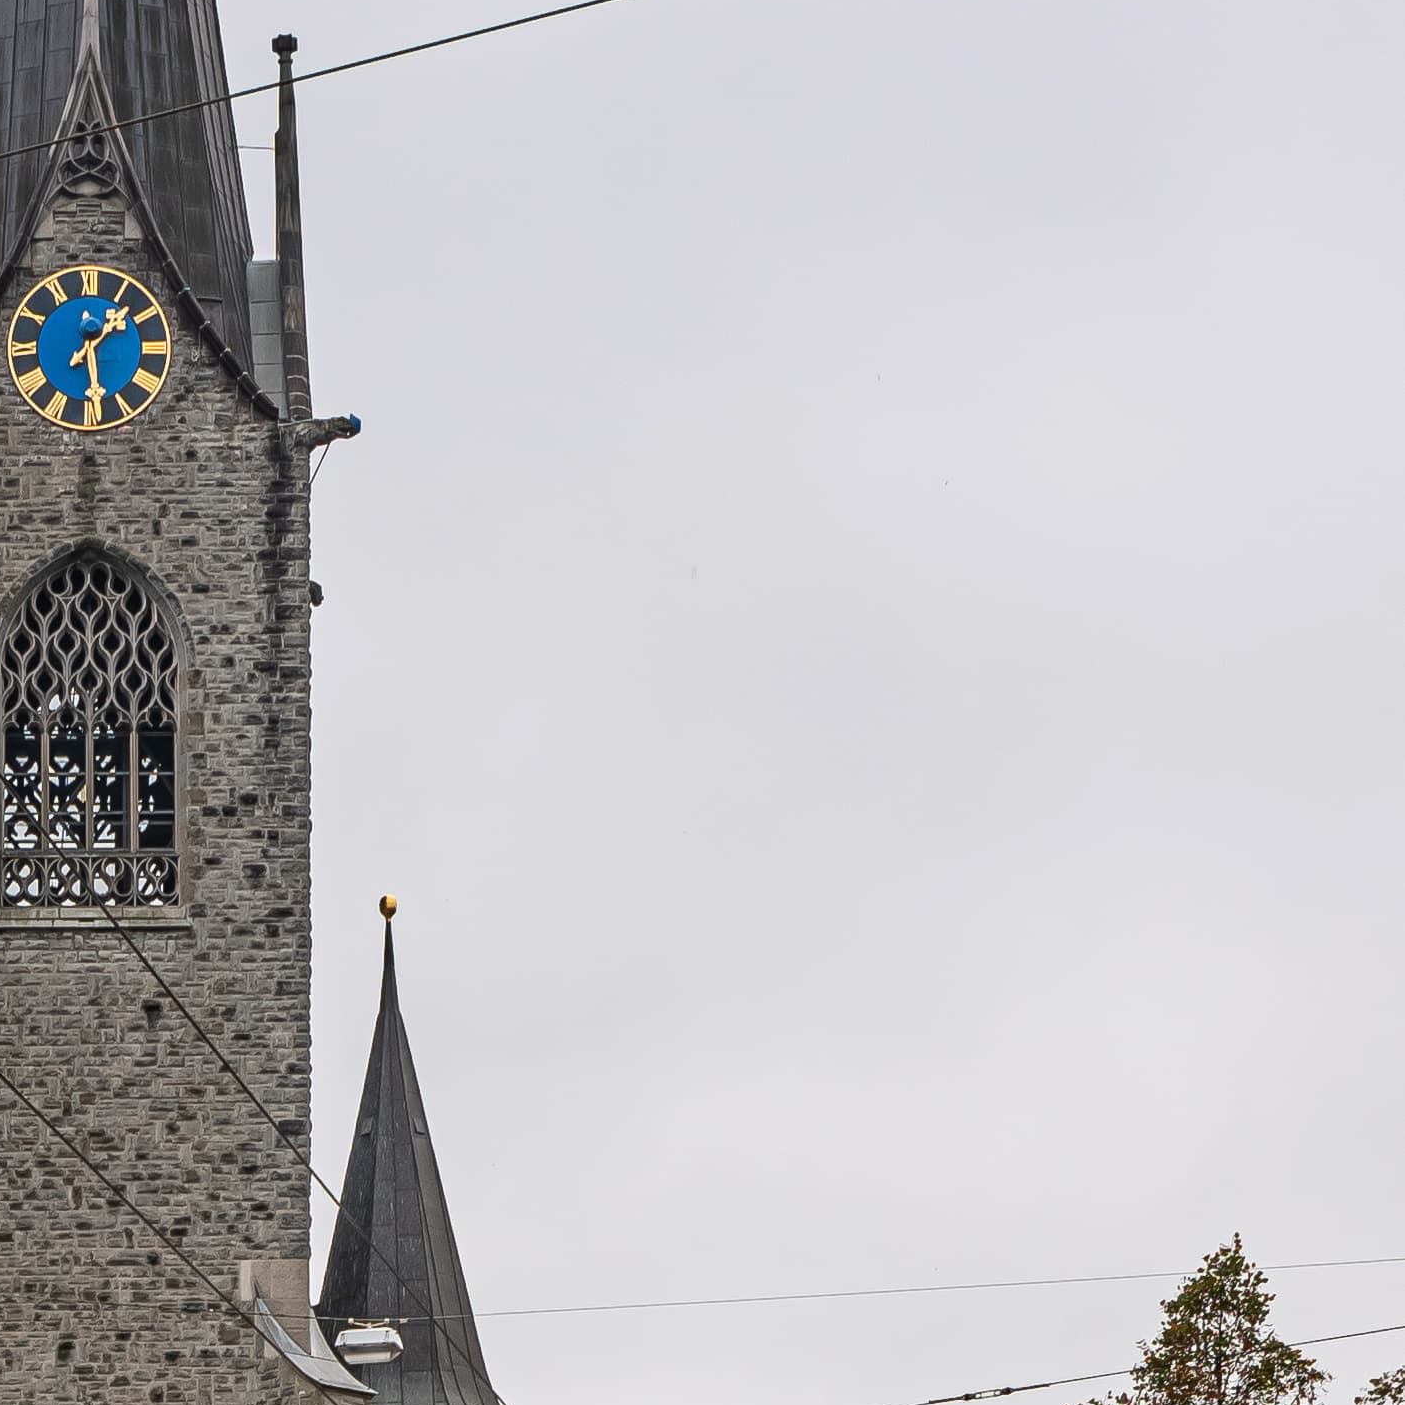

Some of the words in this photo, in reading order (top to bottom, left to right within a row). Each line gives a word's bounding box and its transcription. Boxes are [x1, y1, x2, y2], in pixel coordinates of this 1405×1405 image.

[45, 278, 68, 306] XI
[80, 270, 99, 296] XII
[114, 279, 129, 303] I
[20, 306, 46, 325] X
[133, 305, 158, 324] II
[142, 340, 167, 354] III
[44, 390, 68, 420] VII
[114, 392, 133, 417] V
